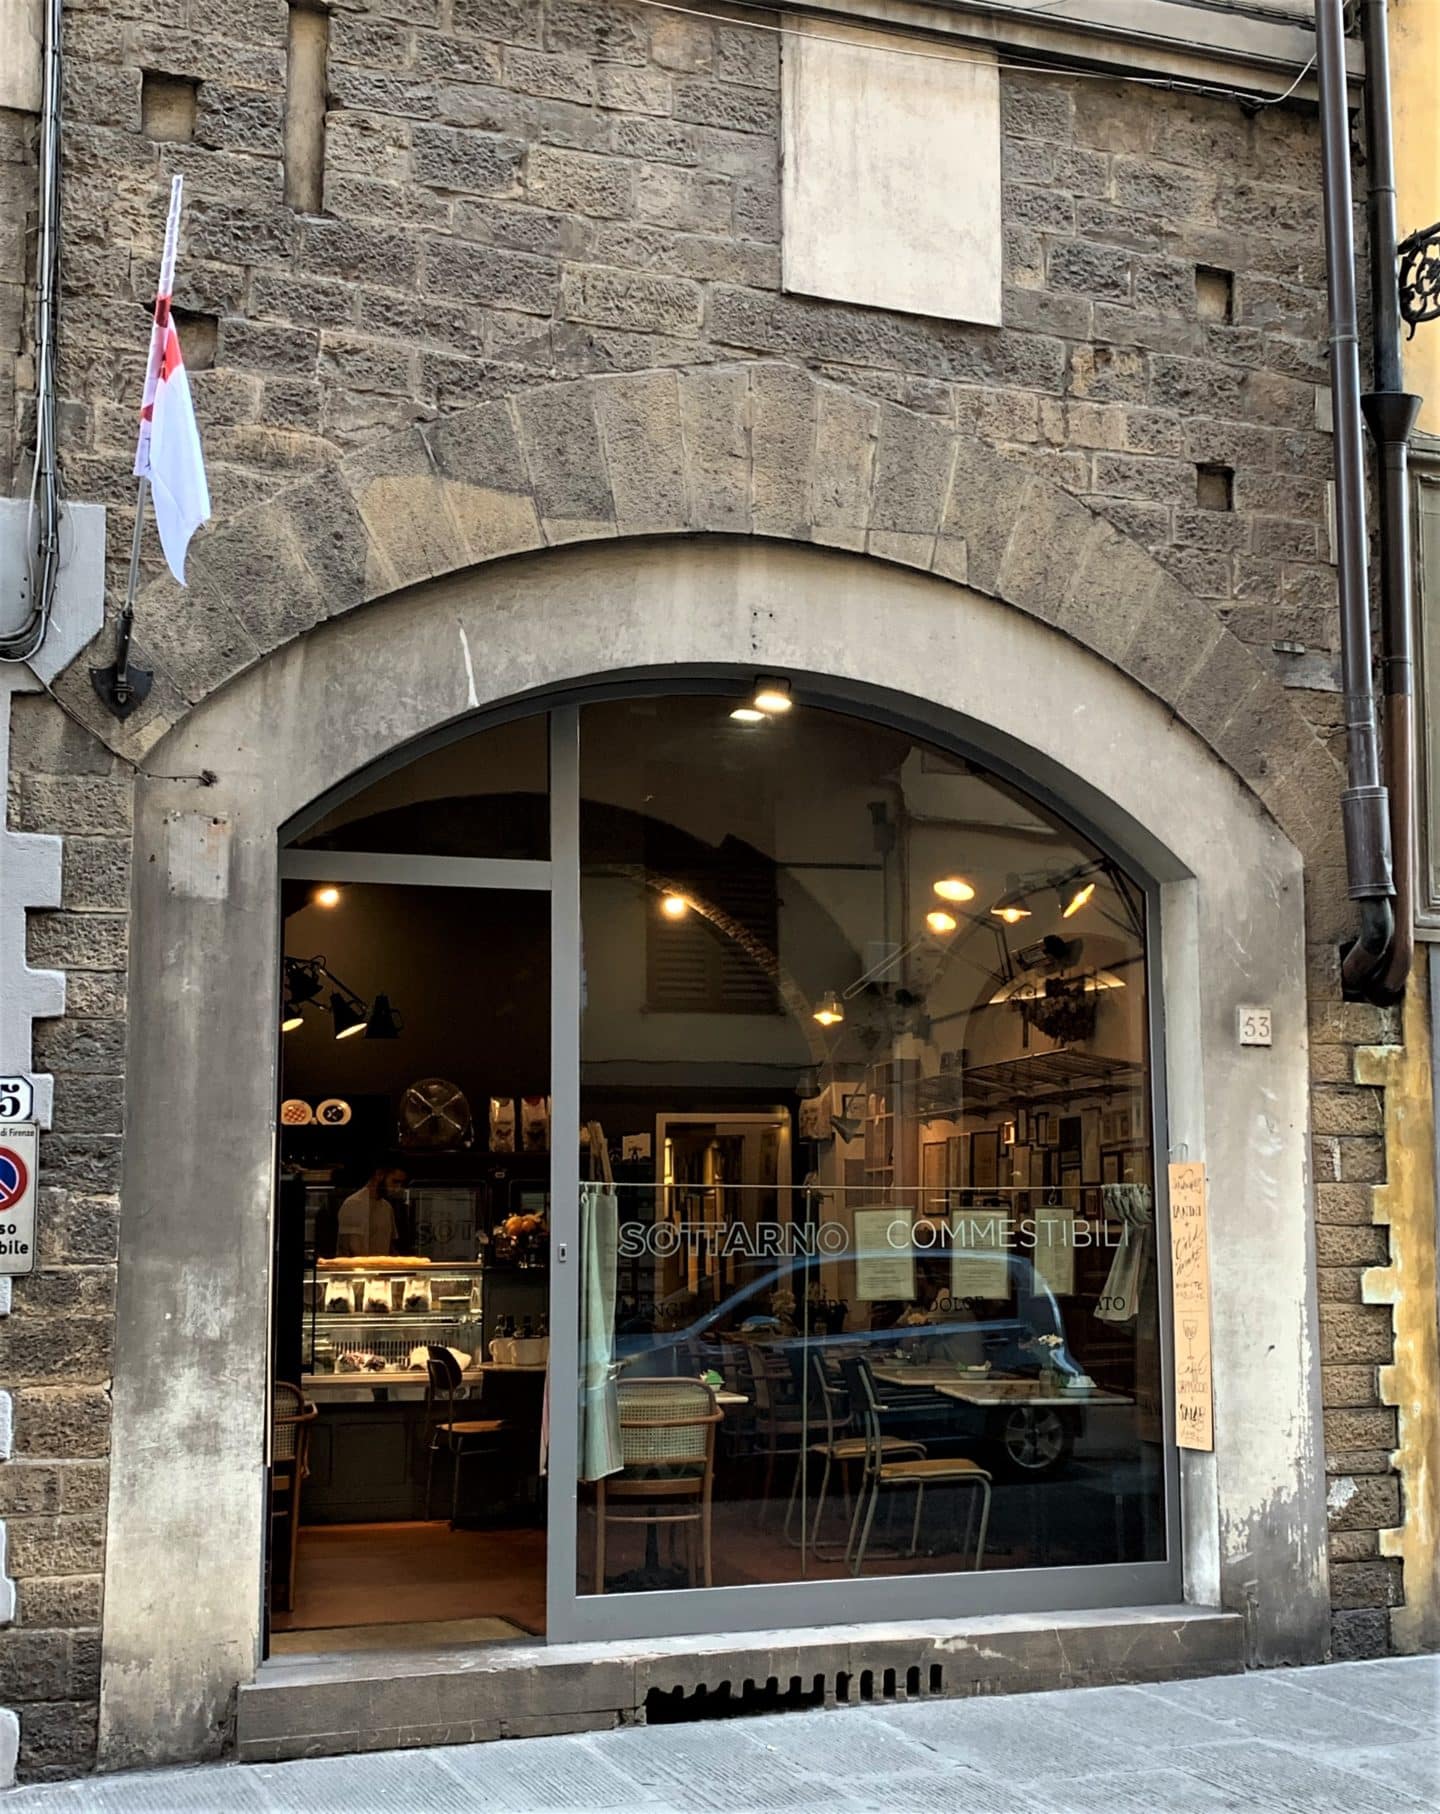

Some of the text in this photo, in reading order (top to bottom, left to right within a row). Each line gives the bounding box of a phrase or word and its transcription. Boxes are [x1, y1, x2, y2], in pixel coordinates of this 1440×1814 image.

[1244, 1016, 1270, 1038] 53
[9, 1128, 35, 1137] Firenze
[618, 1217, 1130, 1258] SOTTARNO COMMESTIBILI
